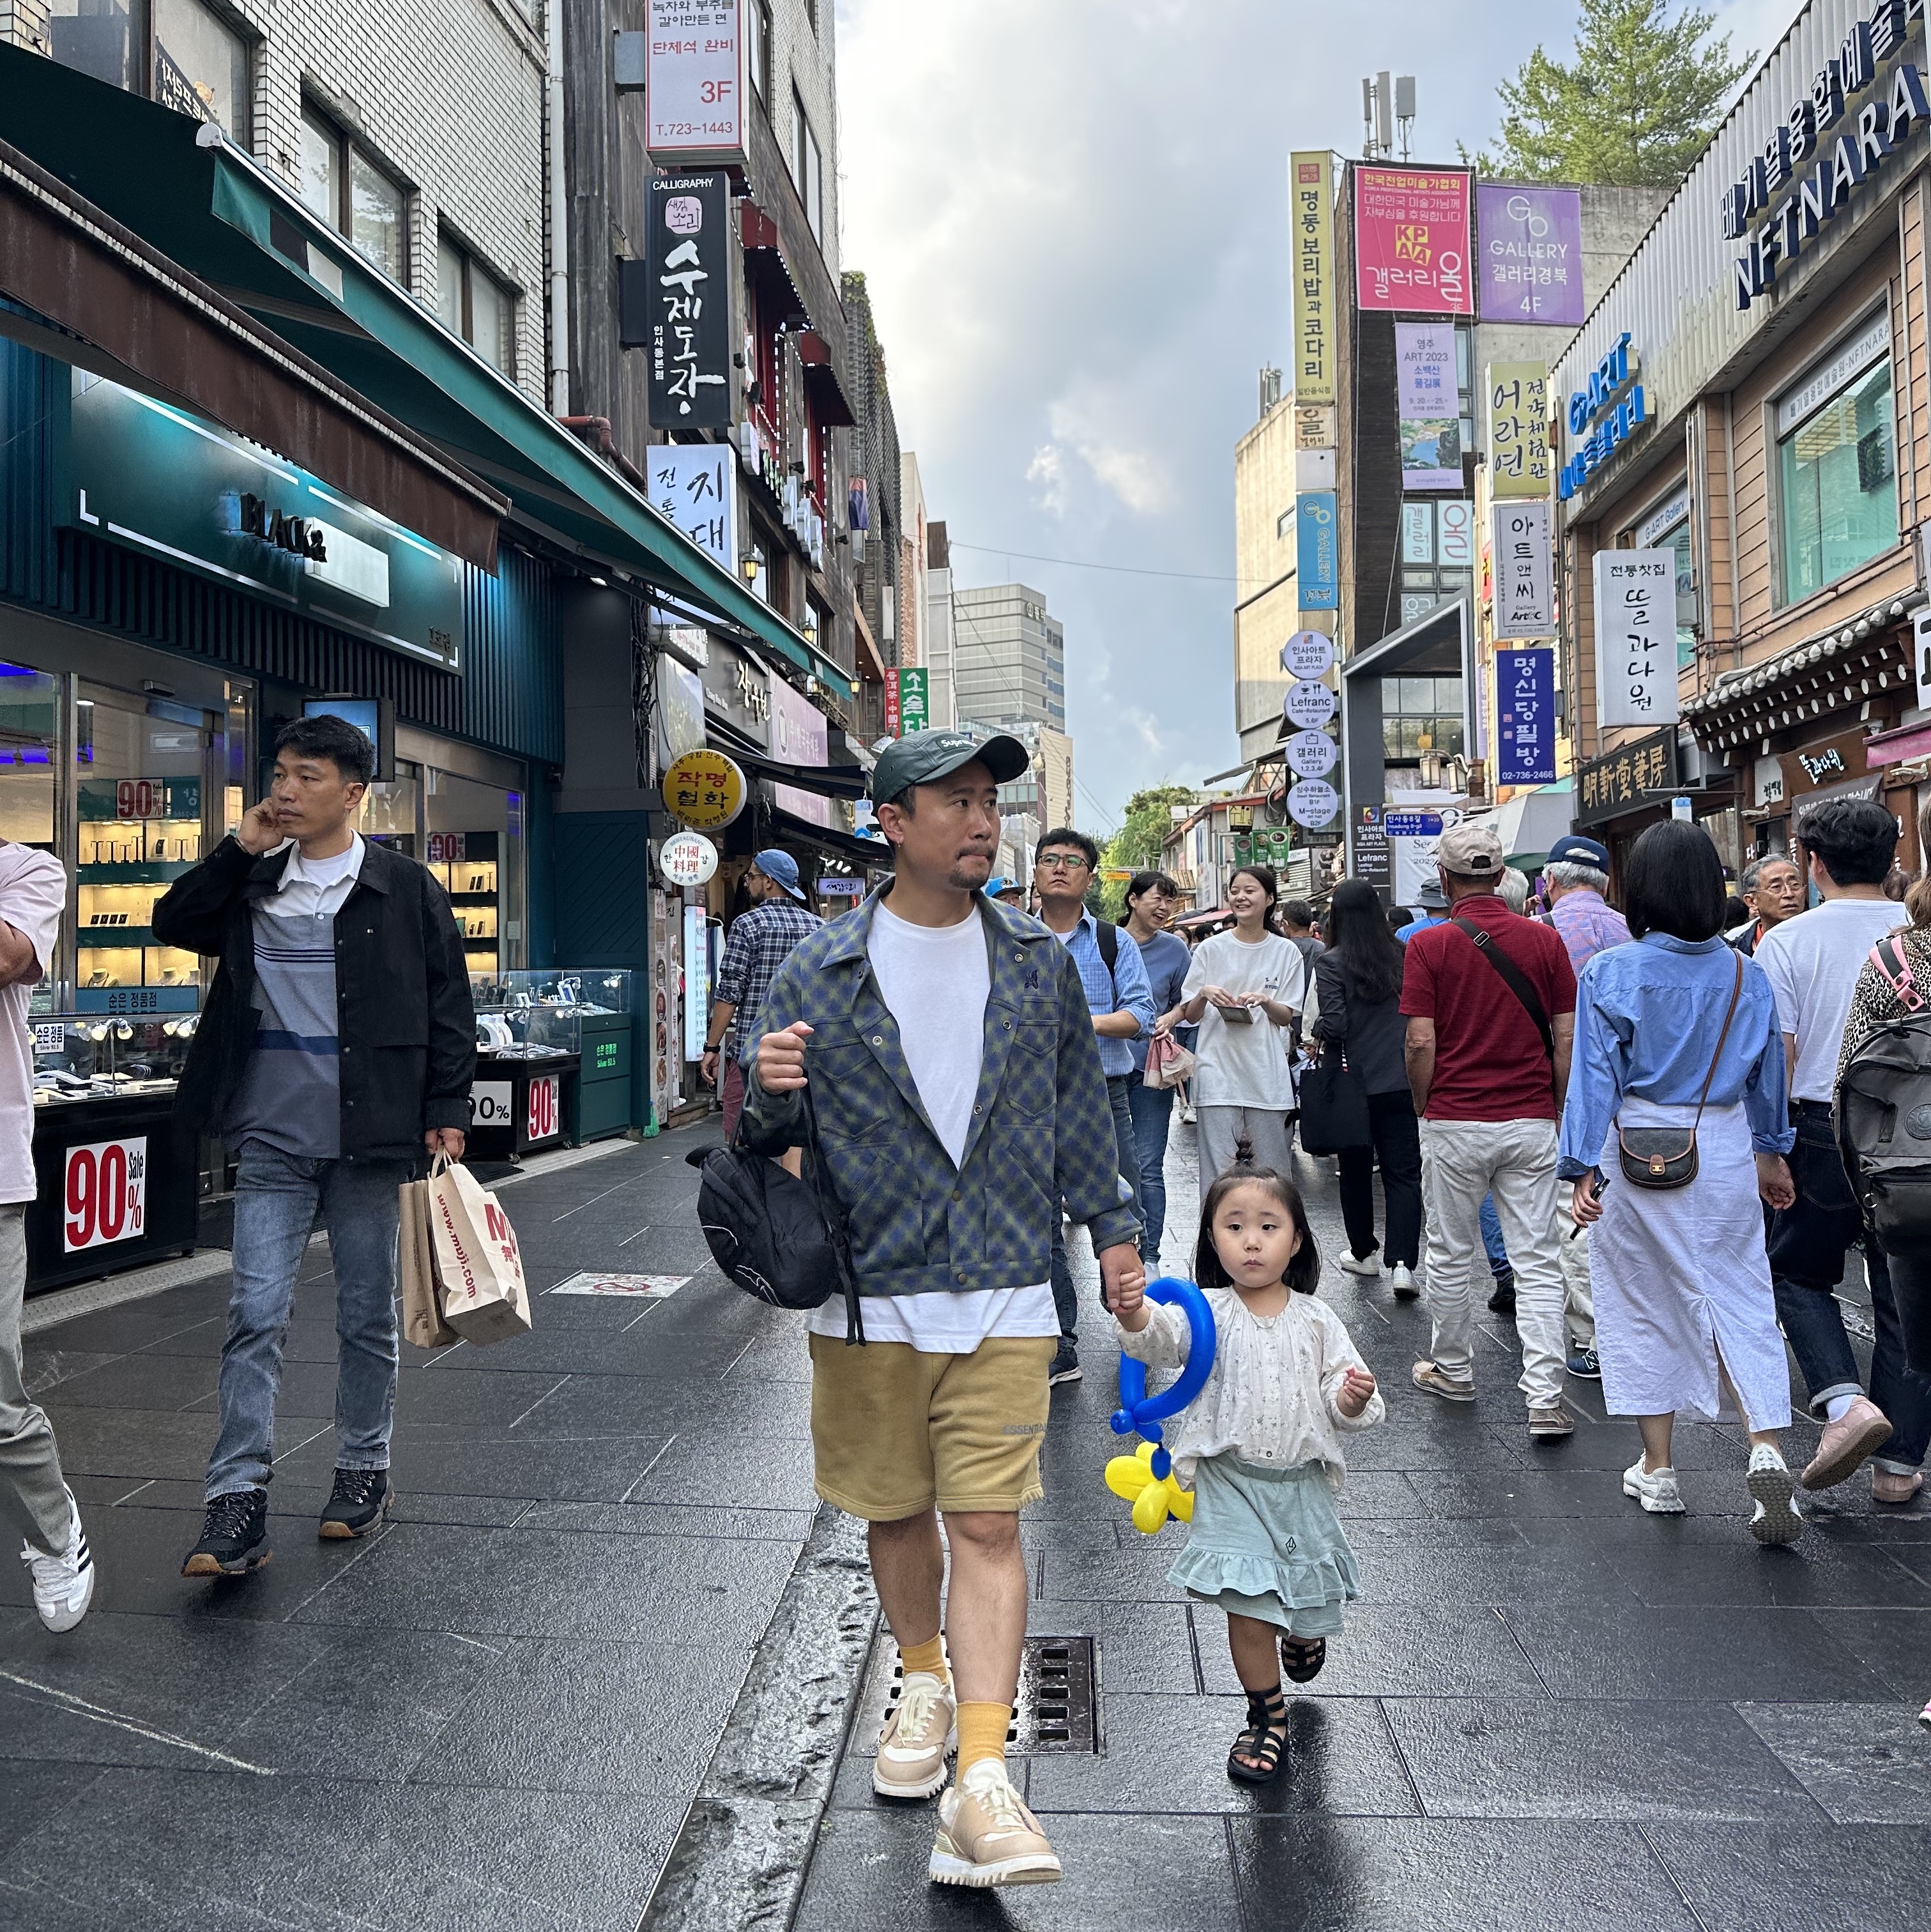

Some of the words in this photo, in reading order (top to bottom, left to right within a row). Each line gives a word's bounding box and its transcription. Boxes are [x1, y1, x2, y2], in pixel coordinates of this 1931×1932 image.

[659, 14, 710, 27] 갈아만든
[715, 13, 727, 25] 면
[653, 40, 696, 55] 단체석
[705, 39, 734, 52] 완비
[701, 80, 733, 103] 3F
[653, 178, 714, 190] CALLIGRAPHY
[1364, 173, 1460, 190] 한국전업미술가협회
[1735, 65, 1924, 310] NFTNARA
[1364, 194, 1405, 207] 대한민국
[1409, 210, 1461, 222] 후원합니다
[1490, 240, 1568, 259] GALLERY
[1493, 264, 1568, 285] 갤러리경북
[1520, 297, 1542, 313] 4F
[1417, 339, 1434, 350] 영주
[1404, 352, 1423, 361] ART
[1426, 353, 1449, 361] 2023
[1414, 365, 1440, 375] 소백산
[1318, 528, 1331, 584] GALLERY
[1610, 564, 1665, 577] 전통찻집
[1292, 646, 1326, 655] 인사아트
[1297, 655, 1322, 664] 프라자
[1291, 697, 1331, 706] Lefranc
[1514, 657, 1540, 766] 명신당필방
[1297, 747, 1327, 757] 갤러리
[1502, 771, 1553, 780] 02-736-2466
[118, 780, 152, 818] 90
[675, 845, 699, 858] 中國
[1357, 854, 1387, 862] Lefranc
[673, 860, 699, 872] 料理
[108, 993, 126, 1009] 순은
[130, 991, 158, 1008] 정품점
[529, 1078, 551, 1138] 90
[128, 1151, 143, 1180] Sale
[66, 1145, 126, 1247] 90
[128, 1183, 141, 1231] %
[437, 1194, 477, 1299] www.muji.com
